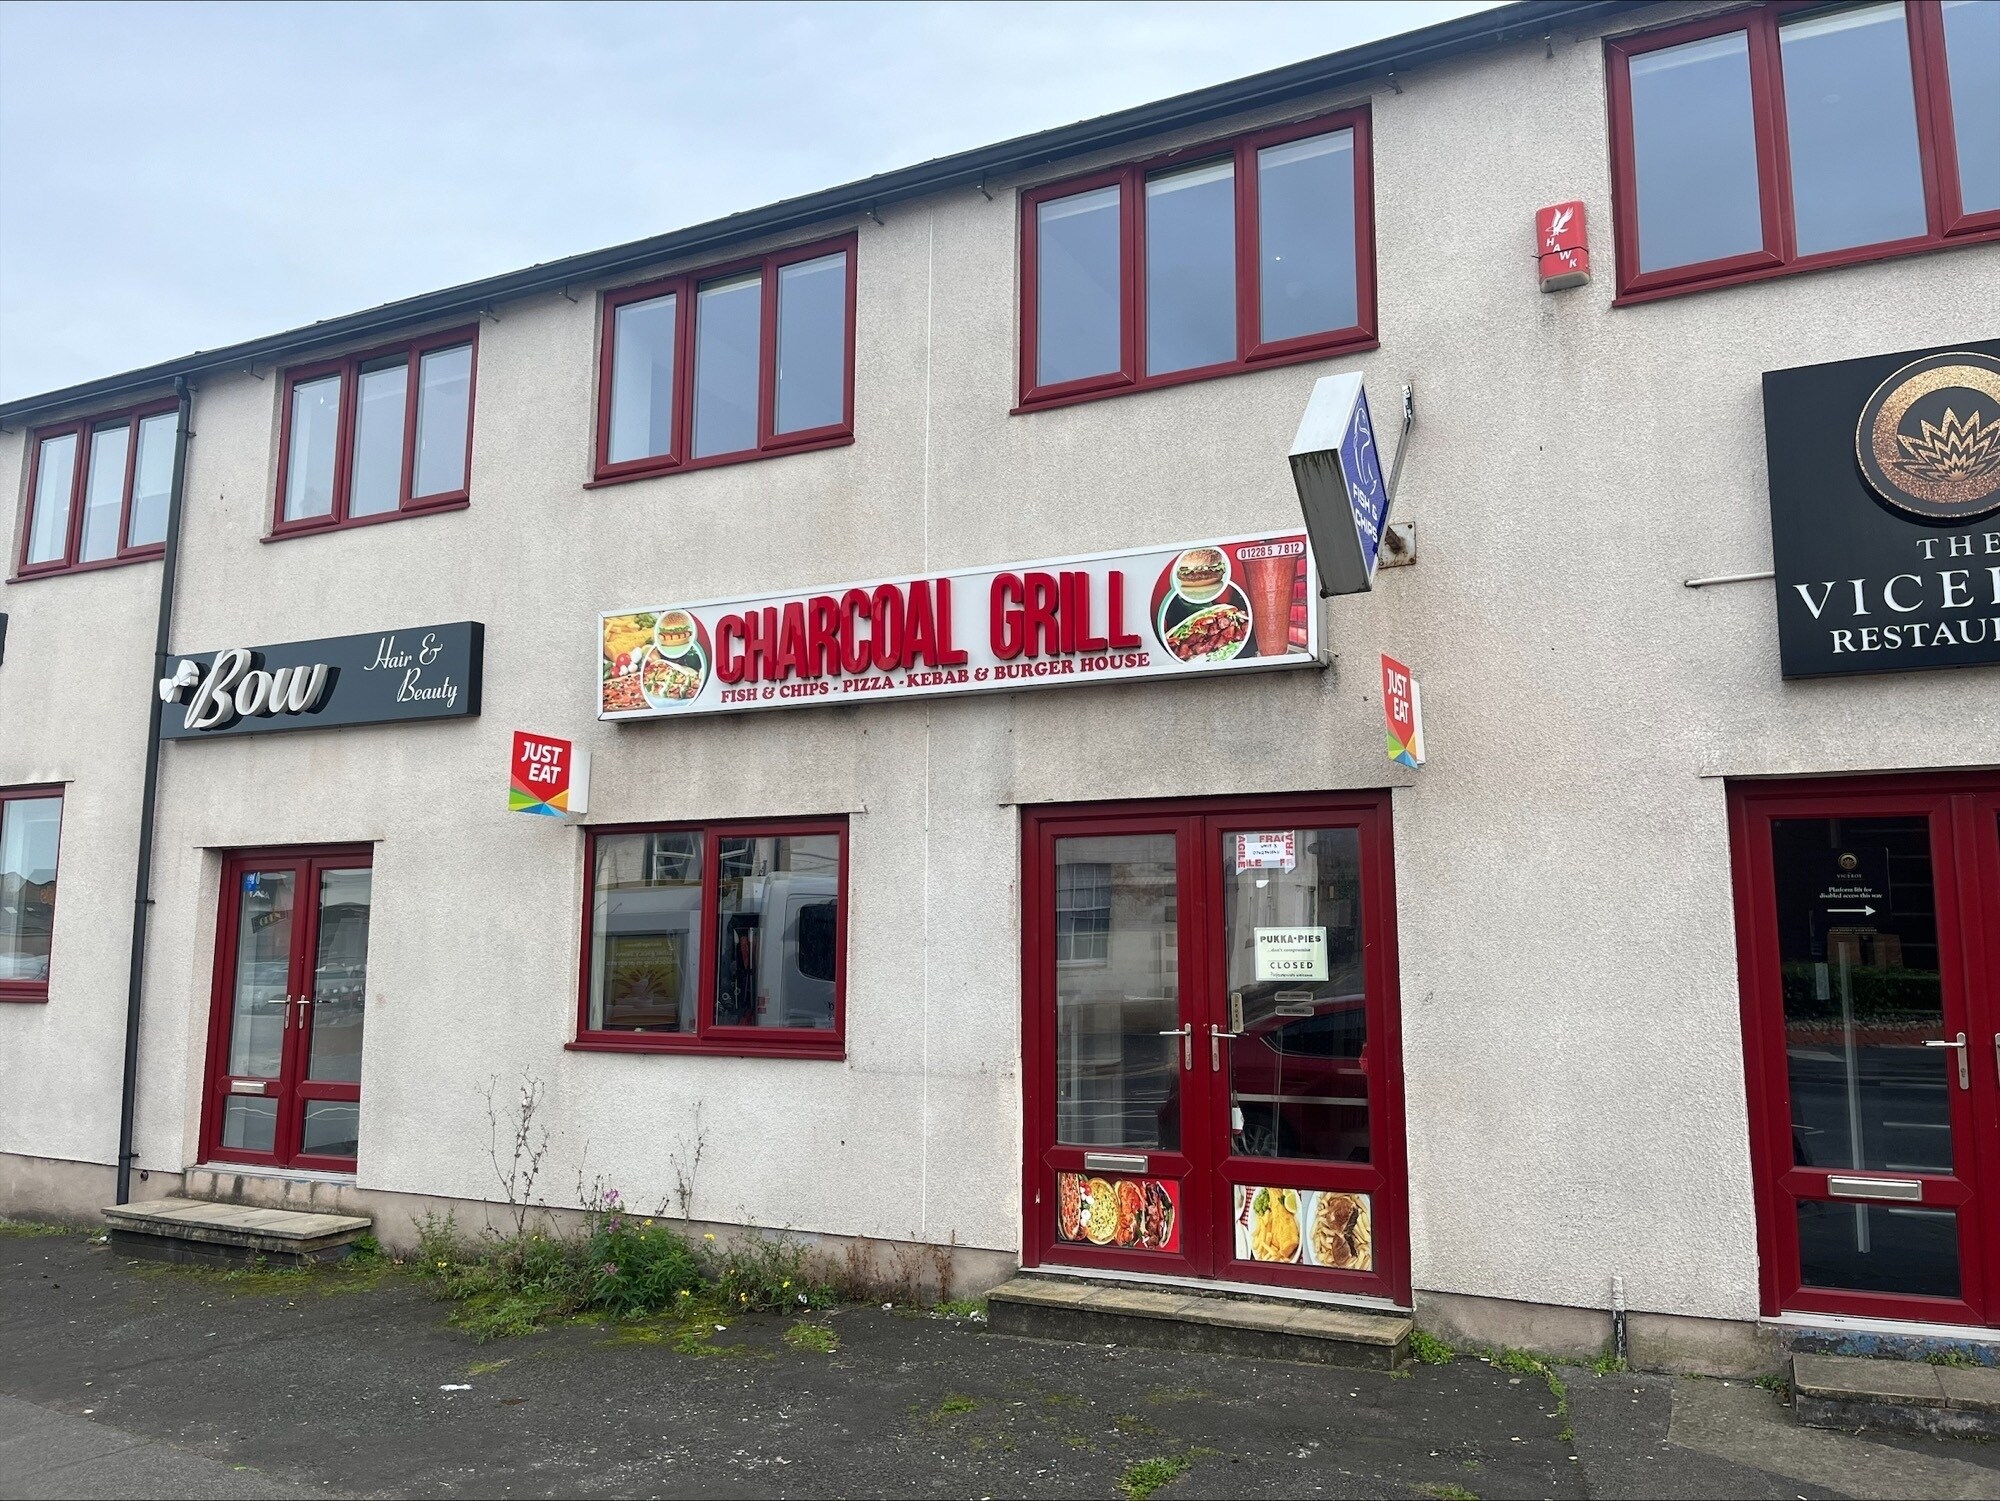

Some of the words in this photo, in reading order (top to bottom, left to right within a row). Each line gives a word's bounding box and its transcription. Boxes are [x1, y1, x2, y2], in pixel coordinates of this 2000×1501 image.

[1546, 237, 1577, 268] HAWK
[1352, 482, 1371, 514] FISH
[1355, 508, 1378, 543] CHIPS
[1916, 532, 2000, 560] THE
[715, 576, 968, 685] CHARCOAL
[990, 570, 1142, 661] GRILL
[364, 635, 413, 671] Hair
[419, 632, 444, 665] &
[183, 648, 329, 730] Bow
[397, 667, 458, 708] Beauty
[721, 688, 758, 703] FISH
[762, 687, 775, 700] &
[779, 681, 829, 699] CHIPS
[843, 675, 894, 692] PIZZA
[907, 668, 969, 688] KEBAB
[974, 667, 990, 682] &
[994, 660, 1074, 680] BURGER
[1080, 652, 1150, 672] HOUSE
[1387, 668, 1407, 699] JUST
[1393, 697, 1409, 724] EAT
[521, 741, 563, 765] JUST
[528, 763, 562, 784] EAT
[1270, 961, 1313, 969] CLOSED
